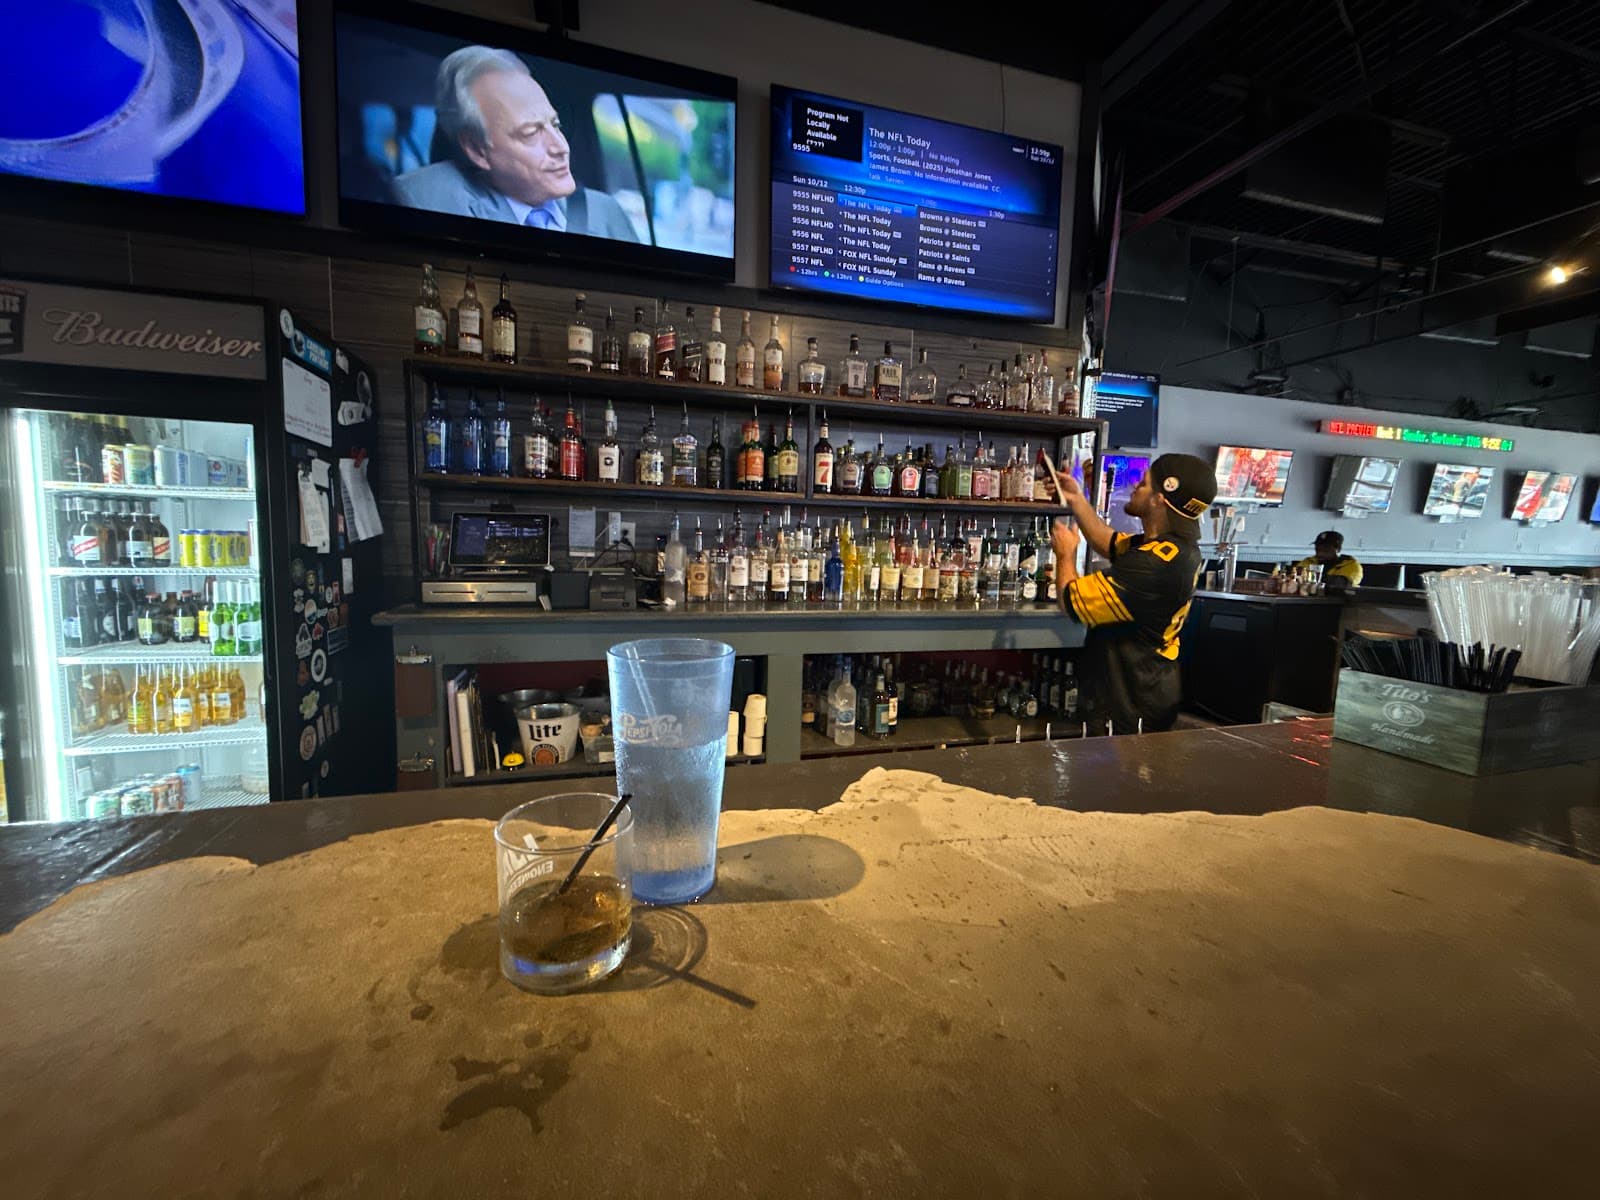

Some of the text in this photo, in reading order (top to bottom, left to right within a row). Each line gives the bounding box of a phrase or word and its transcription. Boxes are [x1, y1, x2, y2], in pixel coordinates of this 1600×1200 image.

[807, 107, 835, 120] Program
[807, 118, 831, 130] Locally
[807, 129, 837, 141] Available
[869, 127, 931, 150] The NFL Today
[793, 143, 811, 153] 9555
[869, 151, 891, 163] Sports,
[922, 161, 944, 172] (2025)
[945, 166, 972, 178] Jonathan
[793, 176, 828, 188] Sun 10/12
[792, 190, 835, 204] 9555 NFLHD
[844, 185, 866, 195] 12:30p
[792, 203, 824, 215] 9555 NFL
[792, 217, 834, 229] 9556 NFLHD
[844, 211, 892, 227] The NFL Today
[920, 212, 943, 222] Browns
[951, 217, 977, 227] Steelers
[792, 229, 824, 241] 9556 NFL
[843, 224, 856, 233] The
[857, 226, 871, 235] NFL
[872, 229, 891, 240] Today
[919, 224, 943, 234] Browns
[951, 229, 976, 239] Steelers
[792, 242, 834, 255] 9557 NFLHD
[843, 237, 891, 253] The NFL Today
[919, 236, 943, 247] Patriots
[952, 242, 971, 251] Saints
[792, 256, 824, 267] 9557 NFL
[843, 250, 856, 259] FOX
[858, 252, 872, 261] NFL
[873, 254, 897, 266] Sunday
[919, 248, 943, 259] Patriots
[951, 254, 971, 264] Saints
[842, 263, 897, 278] FOX NFL Sunday
[918, 261, 936, 270] Rams
[944, 264, 966, 274] Ravens
[918, 273, 935, 282] Rams
[943, 277, 966, 287] Ravens
[42, 308, 262, 358] Budweiser
[818, 460, 830, 483] 7
[1380, 683, 1433, 704] Tito's
[528, 723, 562, 742] Lite
[1370, 722, 1437, 745] Handmade
